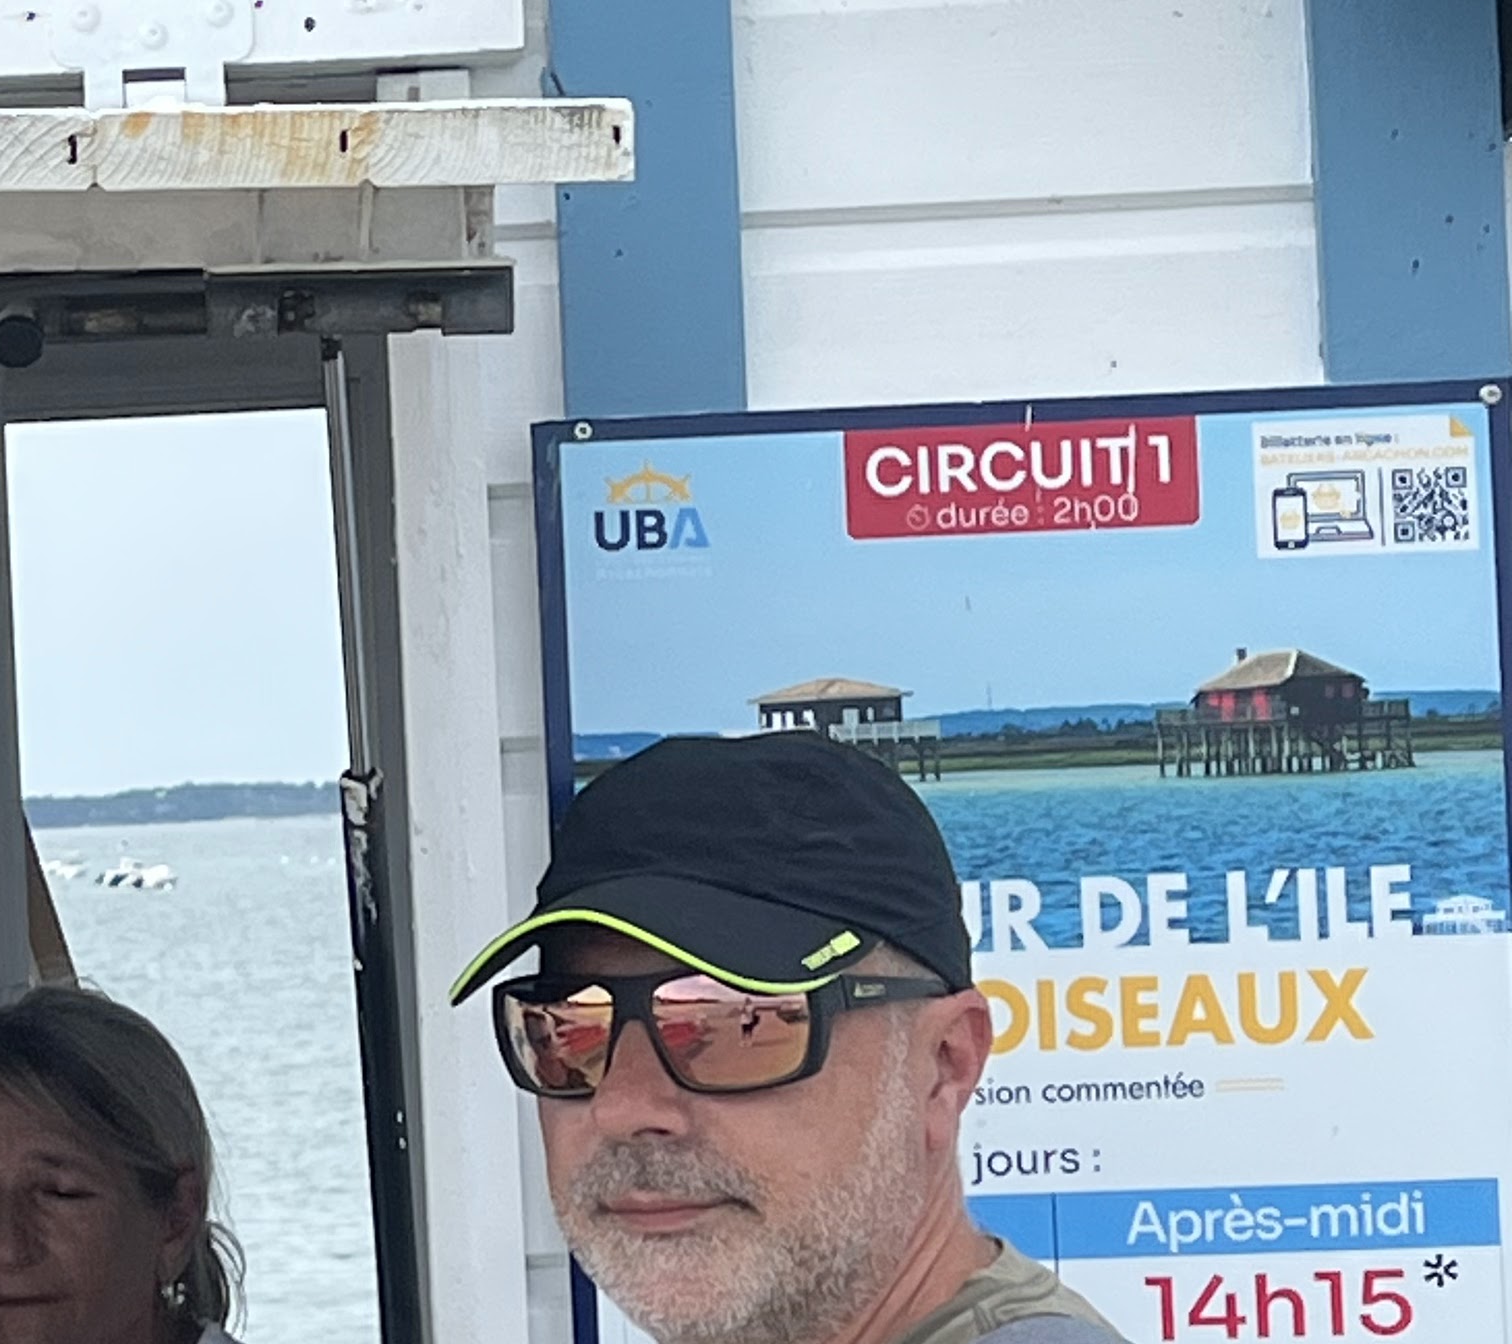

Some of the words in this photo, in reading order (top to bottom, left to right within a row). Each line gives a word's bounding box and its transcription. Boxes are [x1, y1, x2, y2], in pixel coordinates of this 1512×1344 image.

[865, 436, 1134, 497] CIRCUIT
[1147, 434, 1171, 484] 1
[594, 507, 711, 553] UBA
[937, 496, 1029, 529] durée
[1053, 493, 1140, 524] 2h00
[1080, 872, 1190, 948] DE
[974, 967, 1375, 1055] OISEAUX
[1041, 1072, 1205, 1104] commentée
[971, 1143, 1081, 1185] jours
[1126, 1190, 1426, 1253] Après-midi
